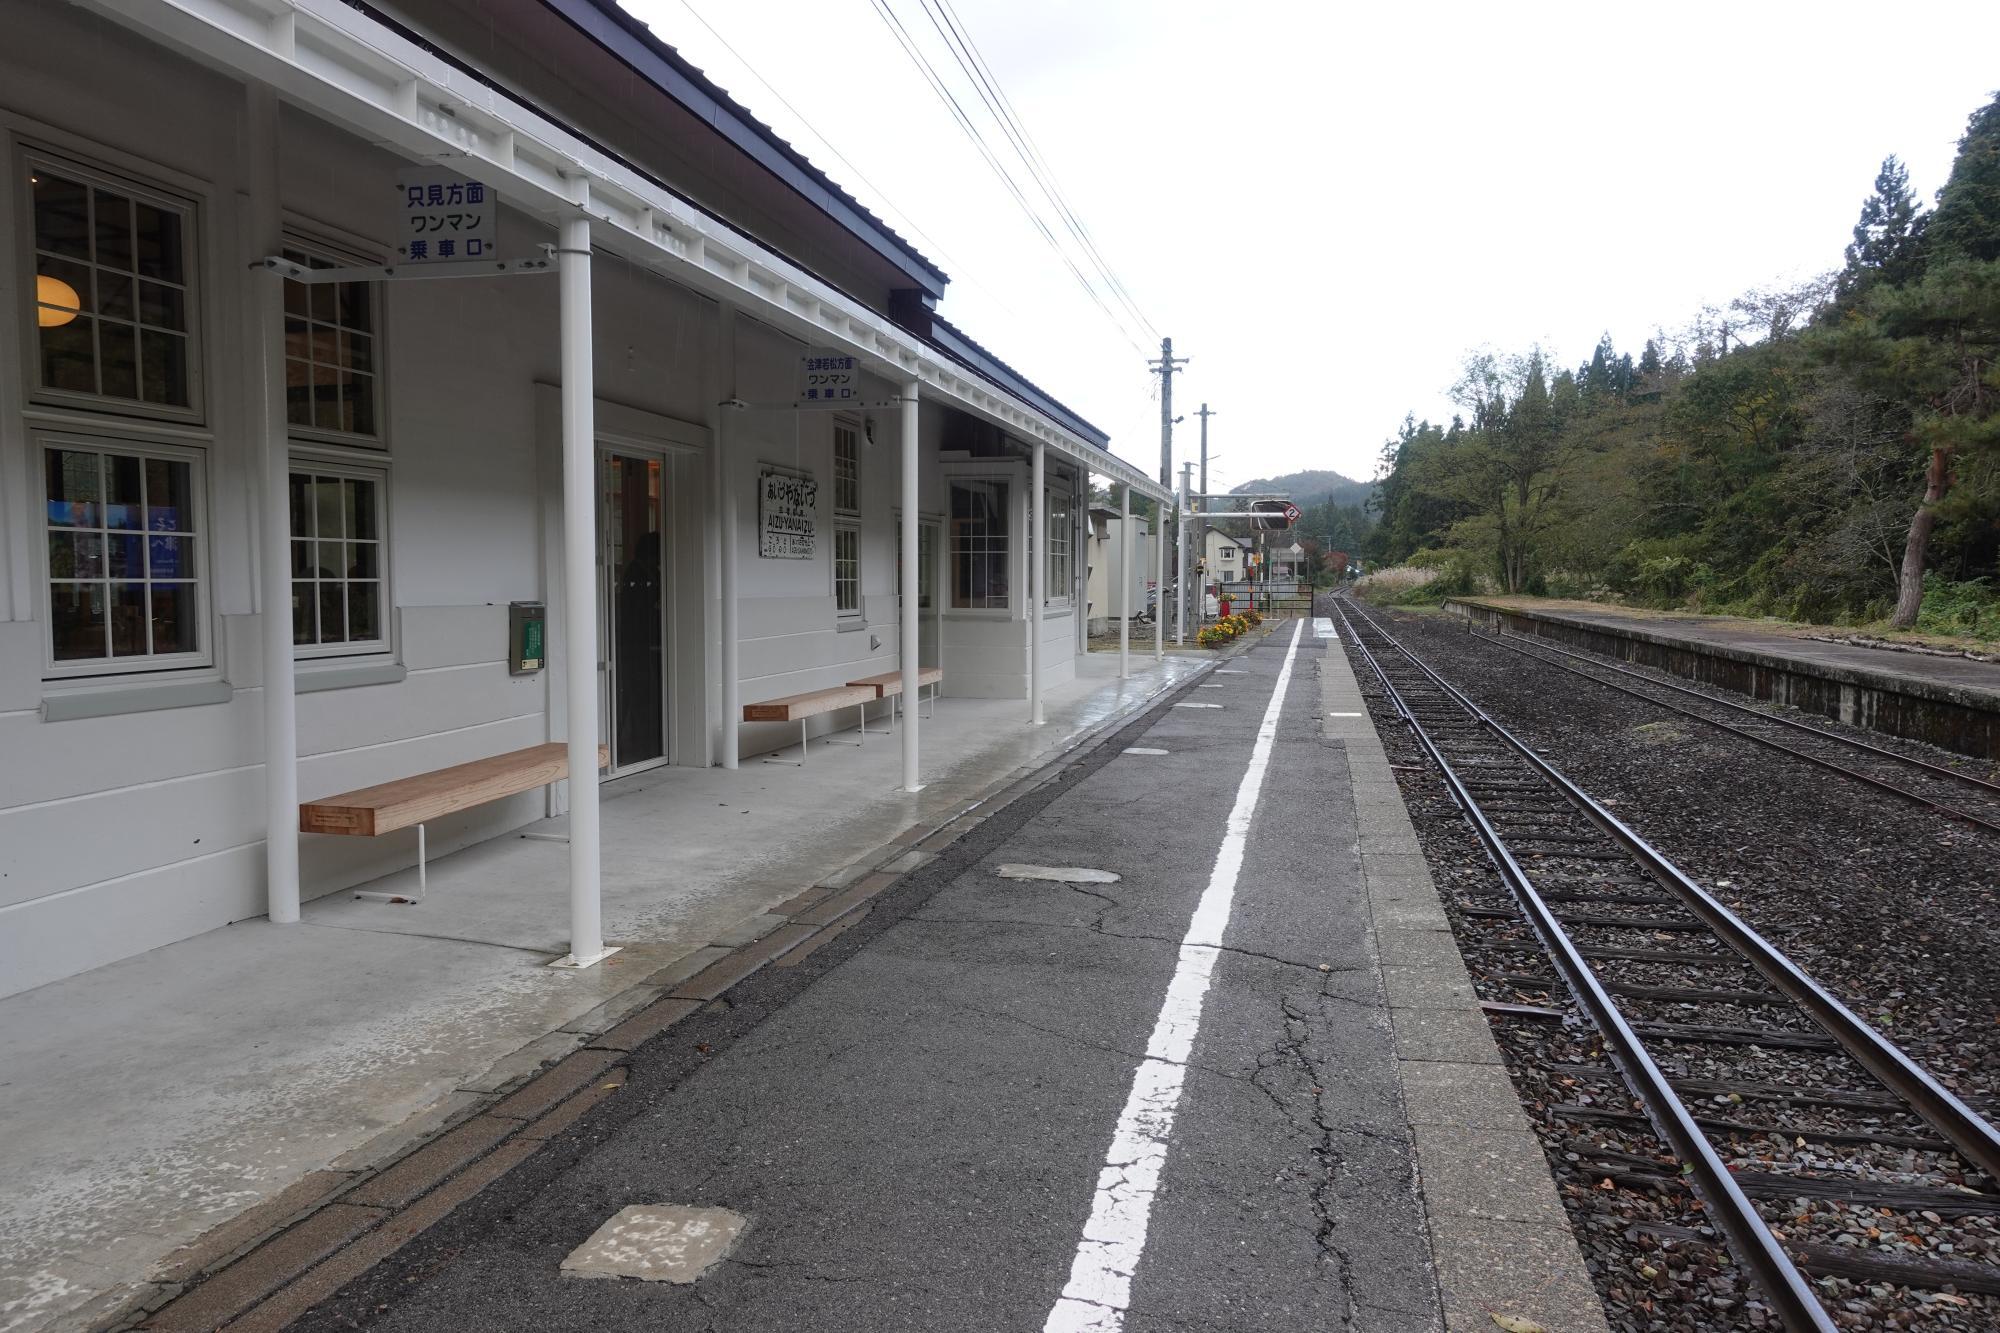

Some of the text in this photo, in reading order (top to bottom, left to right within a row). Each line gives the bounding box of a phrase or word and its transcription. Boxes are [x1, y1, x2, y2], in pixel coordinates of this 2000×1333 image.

[407, 182, 484, 208] 只見方面
[411, 213, 481, 233] ワンマン
[410, 238, 482, 260] 乗車口
[808, 374, 850, 384] ワンマン
[1289, 508, 1295, 517] 2
